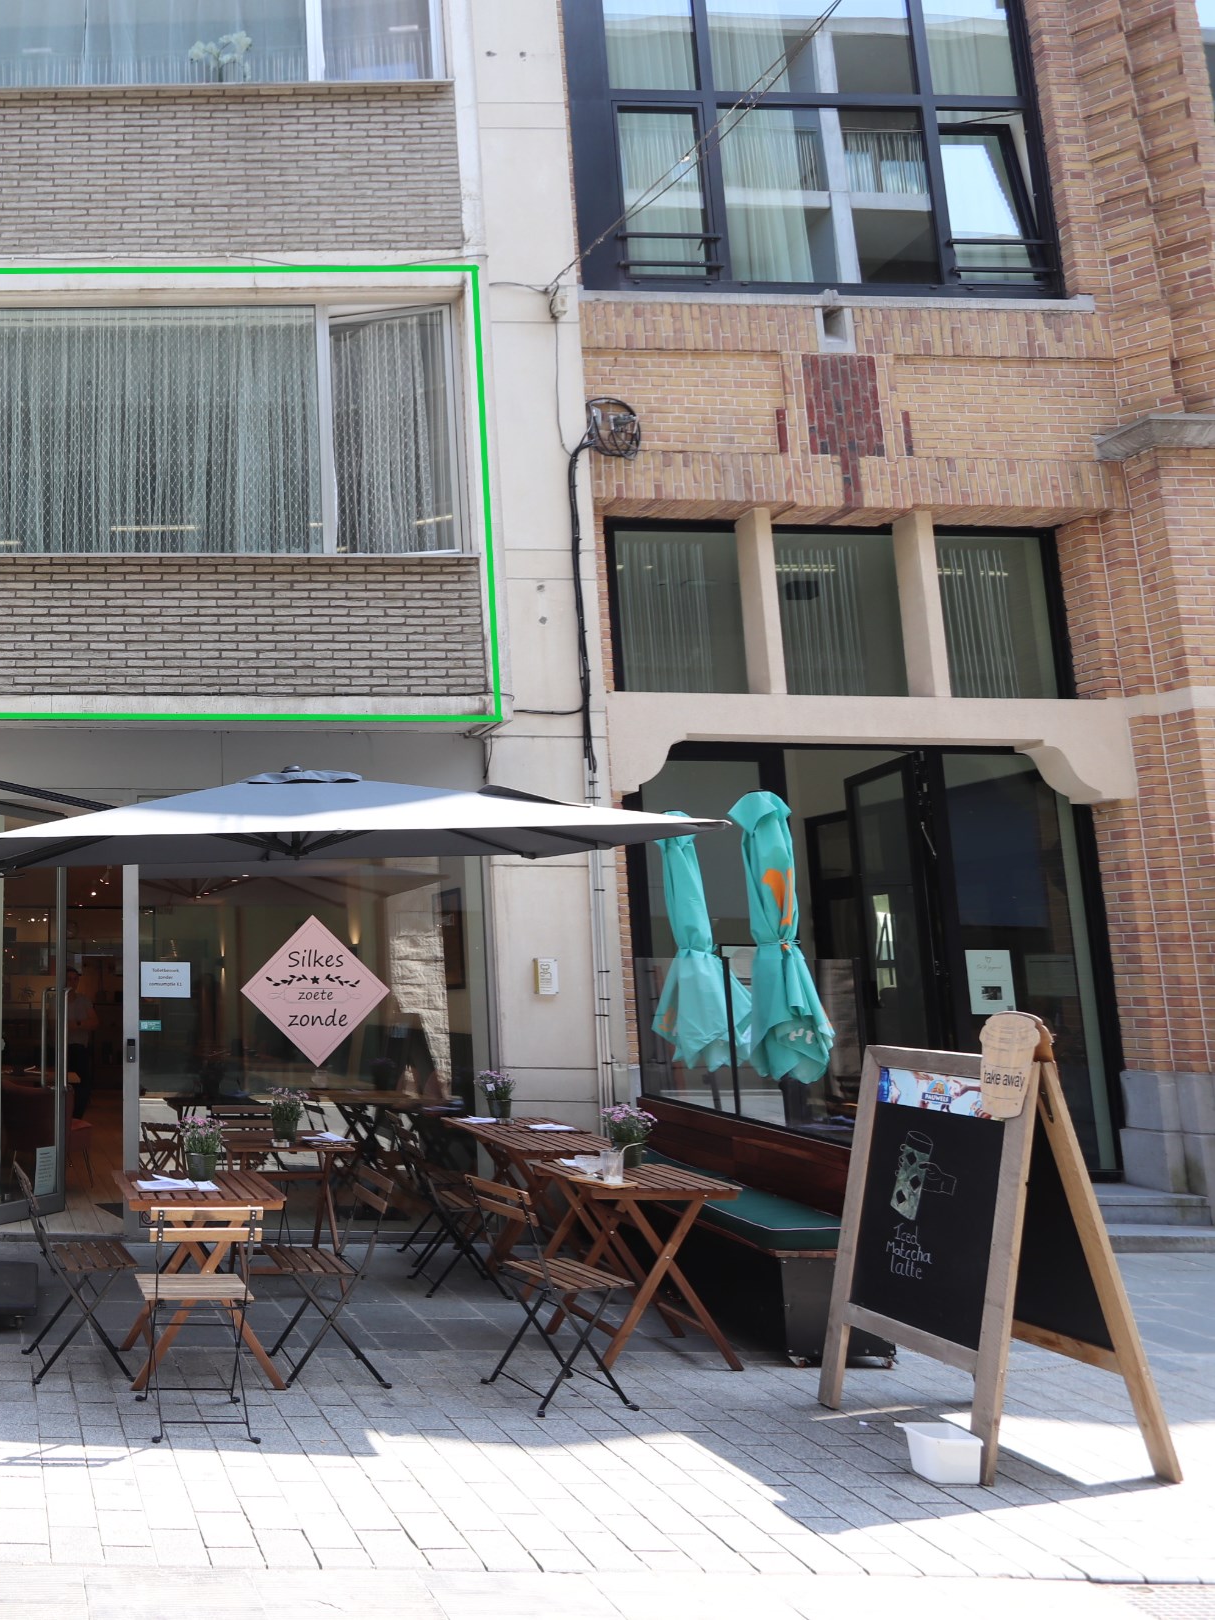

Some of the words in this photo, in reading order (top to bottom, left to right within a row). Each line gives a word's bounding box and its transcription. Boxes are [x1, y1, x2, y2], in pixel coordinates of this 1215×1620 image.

[288, 949, 344, 968] Silkes
[298, 989, 334, 1001] zoete
[288, 1008, 348, 1027] zonde
[983, 1070, 1002, 1086] take
[1002, 1074, 1025, 1091] away
[893, 1222, 921, 1247] Iced
[890, 1254, 923, 1280] latte
